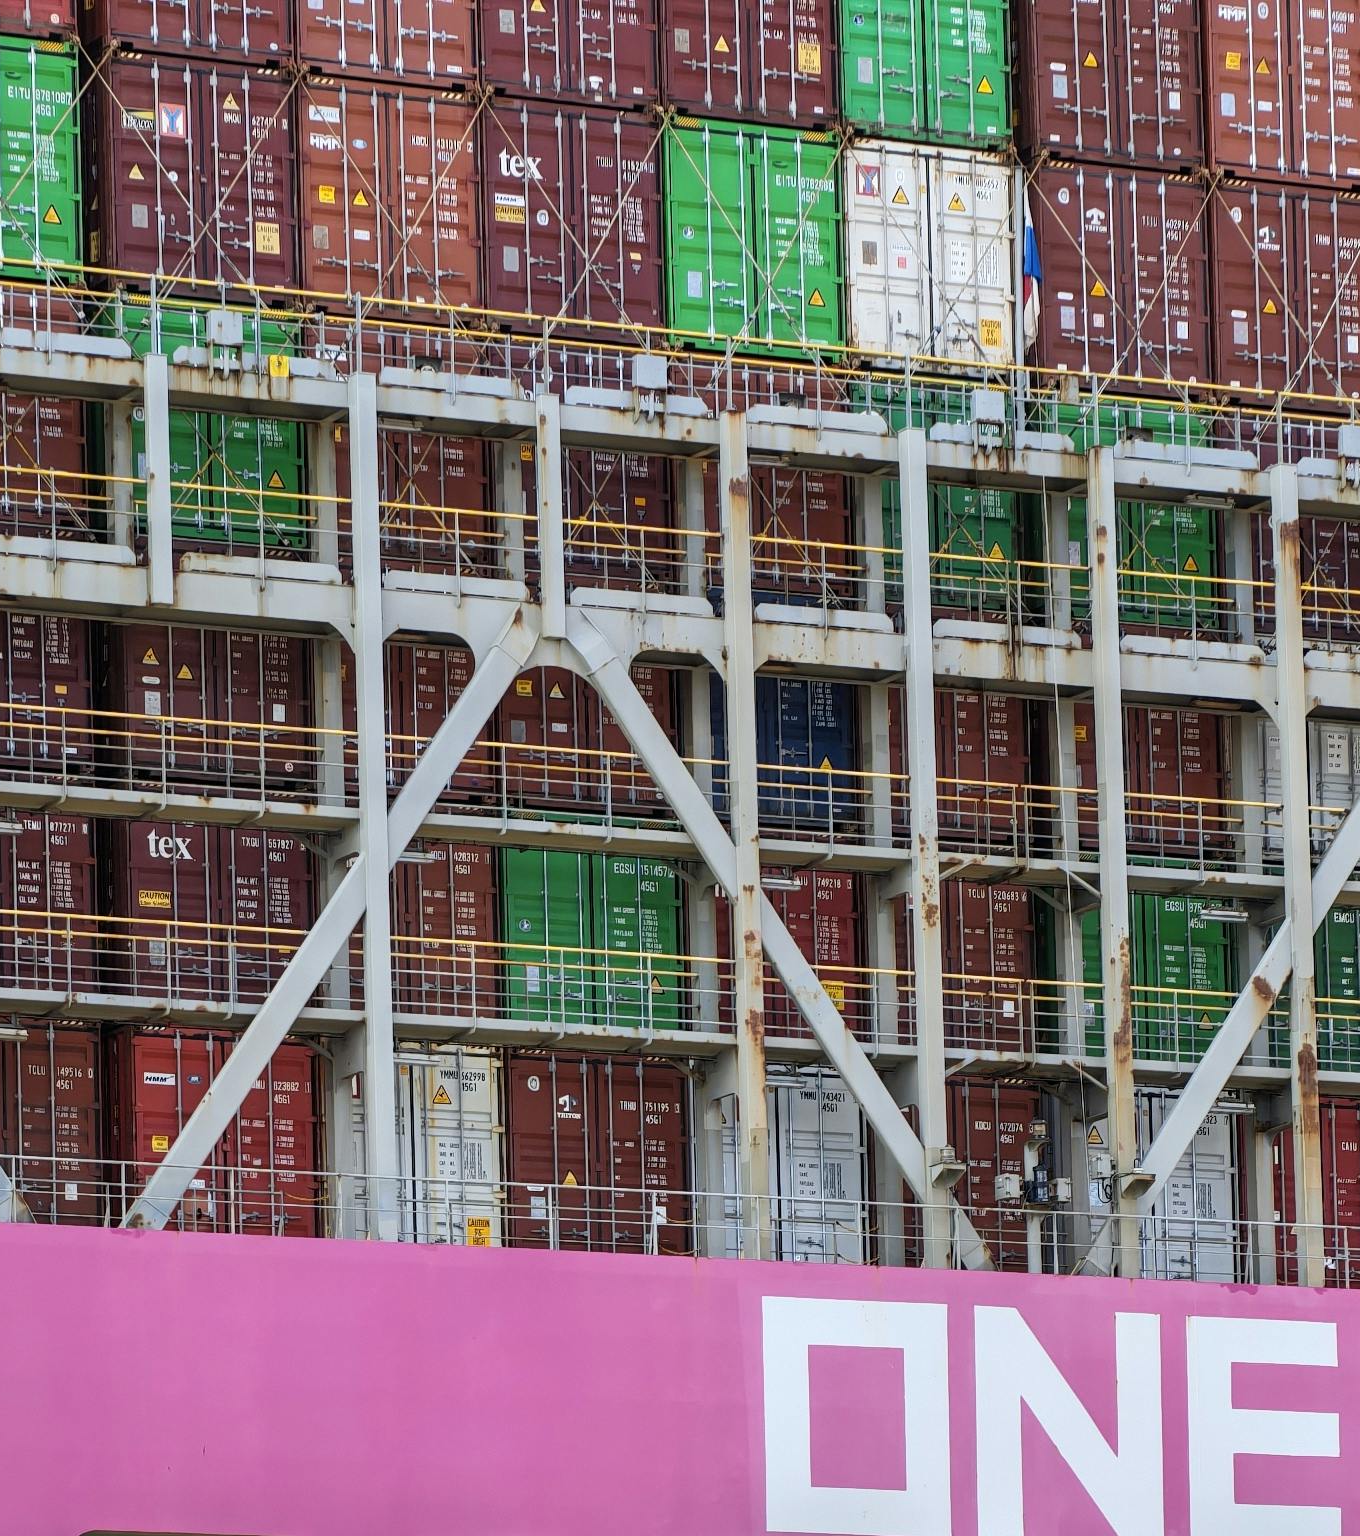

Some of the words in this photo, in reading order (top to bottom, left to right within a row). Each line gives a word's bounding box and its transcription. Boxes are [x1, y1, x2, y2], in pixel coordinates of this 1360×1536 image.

[8, 85, 30, 99] EITU
[36, 105, 55, 117] 45G1
[499, 148, 543, 179] tex
[495, 206, 524, 216] CAUTION
[24, 820, 41, 830] TEMU
[51, 836, 68, 846] 45G1
[148, 829, 193, 860] tex
[242, 837, 260, 847] TXGU
[269, 852, 286, 862] 45G1
[455, 864, 471, 874] 45G1
[614, 863, 635, 874] EGSU
[641, 881, 659, 892] 45G1
[817, 878, 841, 888] 749218
[847, 880, 851, 889] 3
[140, 892, 170, 901] CAUTION
[817, 889, 833, 900] 45G1
[994, 891, 1019, 901] 520683
[994, 902, 1011, 912] 45G1
[1165, 901, 1184, 912] EGSU
[1334, 912, 1355, 923] EMCU
[1190, 917, 1207, 929] 45G1
[28, 1065, 45, 1075] TCLU
[57, 1067, 82, 1077] 149516
[88, 1068, 93, 1079] 0
[440, 1070, 458, 1080] YMMU
[57, 1080, 73, 1090] 45G1
[274, 1094, 291, 1104] 45G1
[800, 1091, 816, 1100] YMMU
[822, 1092, 845, 1101] 743421
[645, 1103, 669, 1111] 751195
[675, 1104, 680, 1113] 3
[823, 1103, 837, 1112] 45G1
[646, 1114, 661, 1124] 45G1
[1000, 1134, 1014, 1143] 45G1
[1341, 1142, 1357, 1151] CAIU
[467, 1219, 489, 1227] CAUTION
